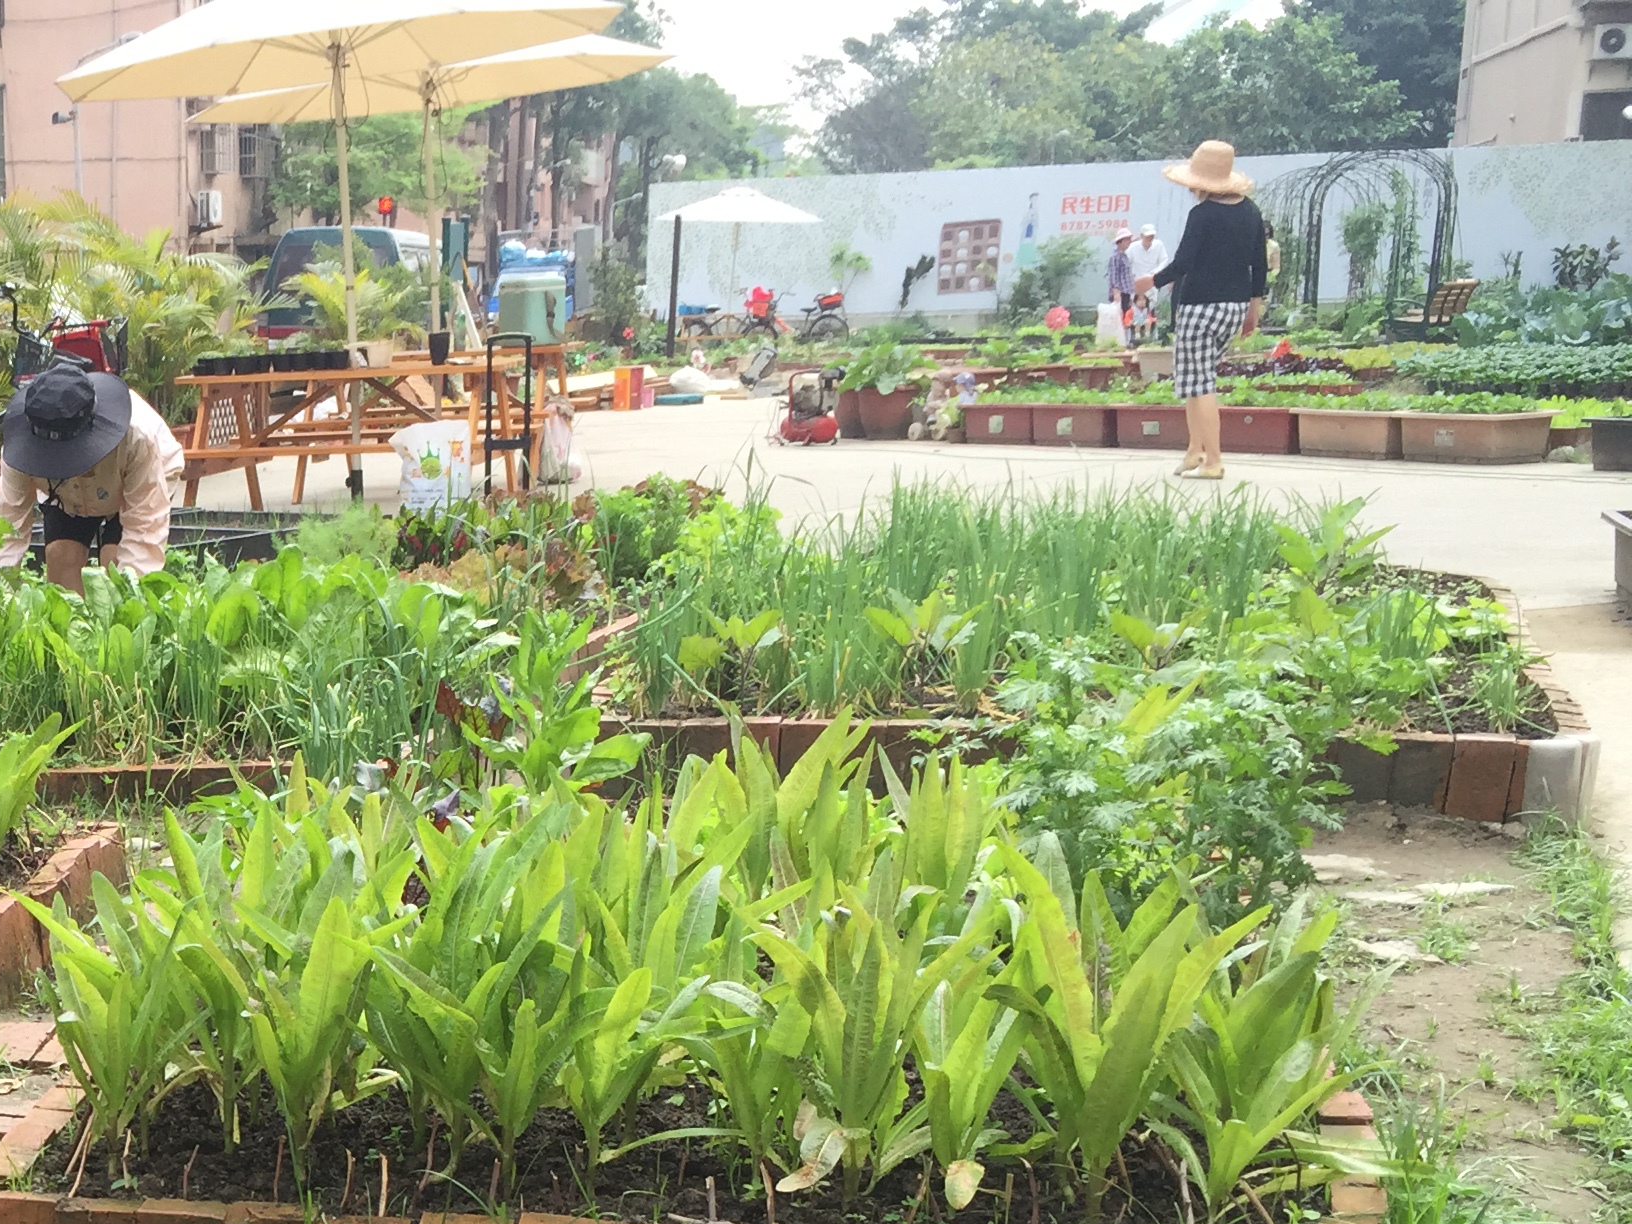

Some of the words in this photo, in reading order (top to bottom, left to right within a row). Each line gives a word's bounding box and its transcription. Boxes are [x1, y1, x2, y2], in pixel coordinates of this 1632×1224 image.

[1061, 194, 1131, 215] 民生日月
[1060, 219, 1128, 231] 8787-5988
